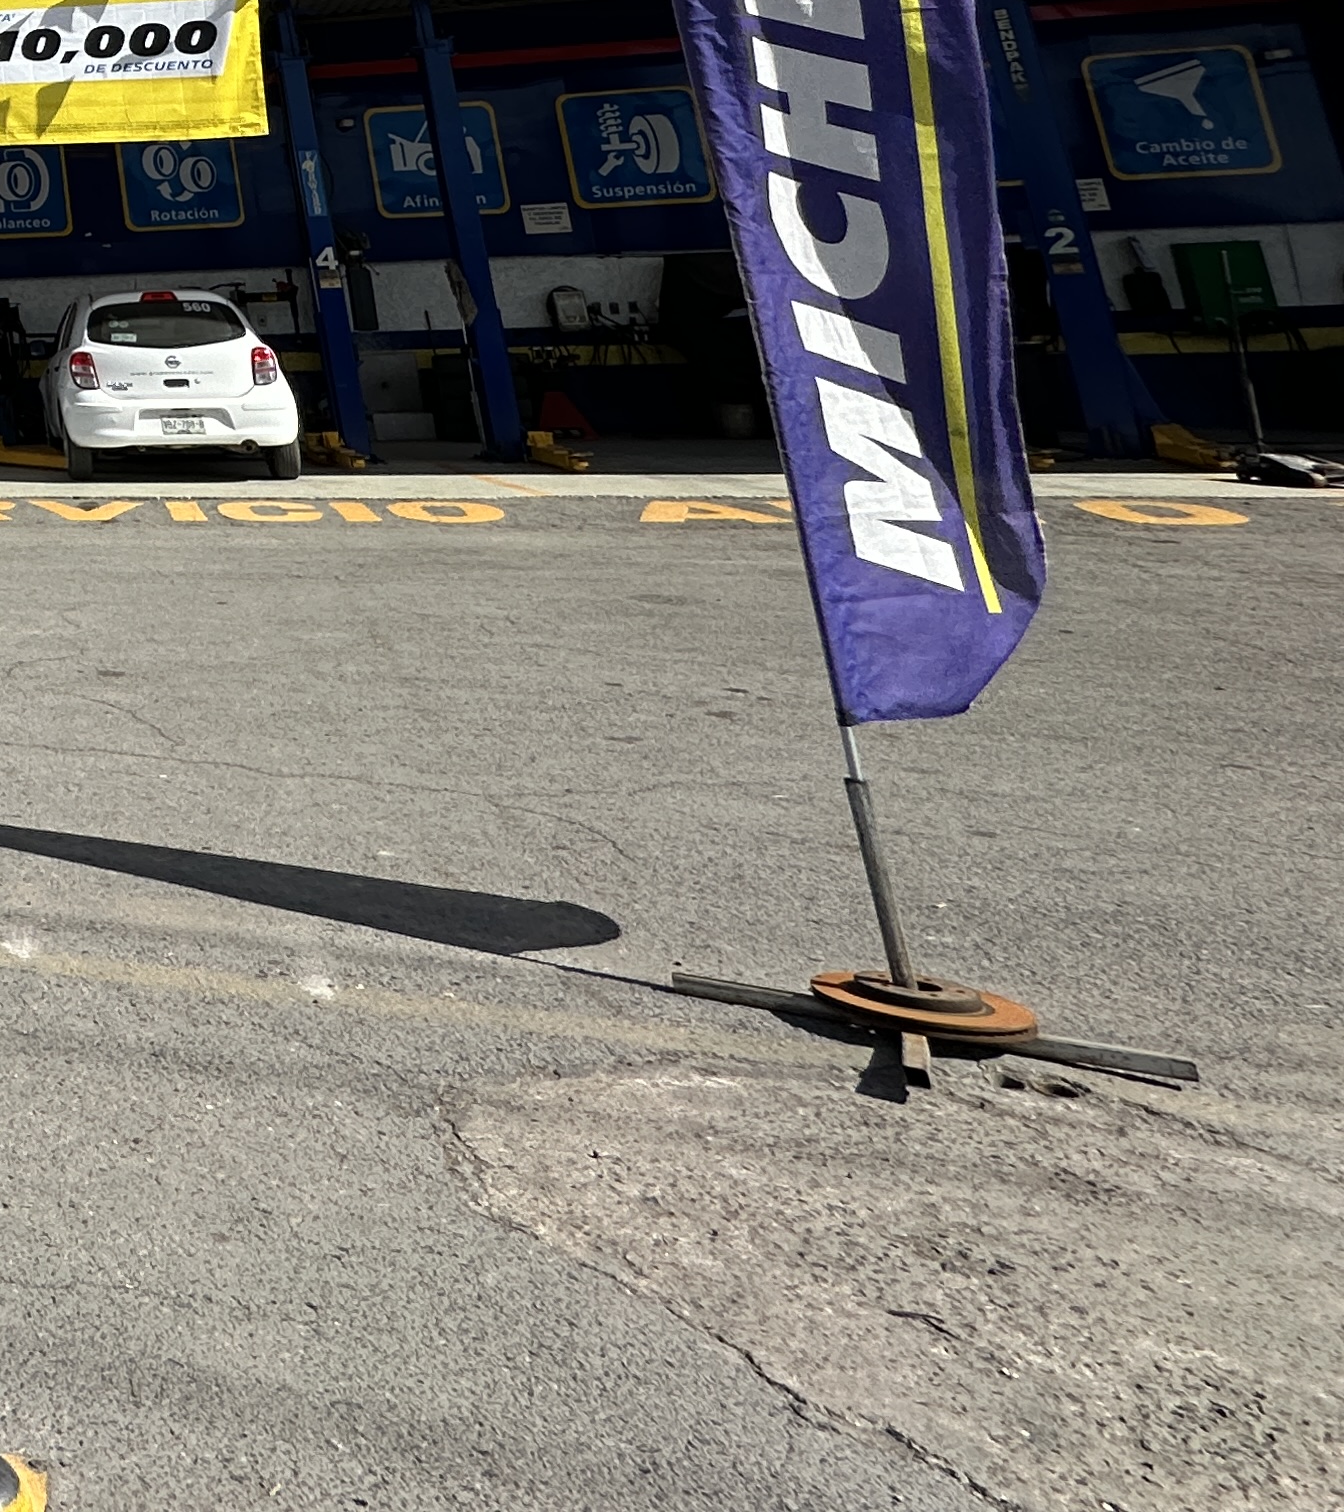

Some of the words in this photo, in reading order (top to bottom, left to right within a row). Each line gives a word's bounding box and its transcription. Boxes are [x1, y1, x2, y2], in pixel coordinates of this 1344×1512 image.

[84, 64, 107, 75] DE
[111, 59, 214, 74] DESCUENTO
[1136, 137, 1215, 155] Cambio
[1221, 136, 1247, 150] de
[1162, 150, 1229, 167] Aceite
[592, 181, 697, 200] Suspensión
[150, 207, 219, 221] Rotación
[1044, 227, 1080, 255] 2
[316, 246, 339, 270] 4
